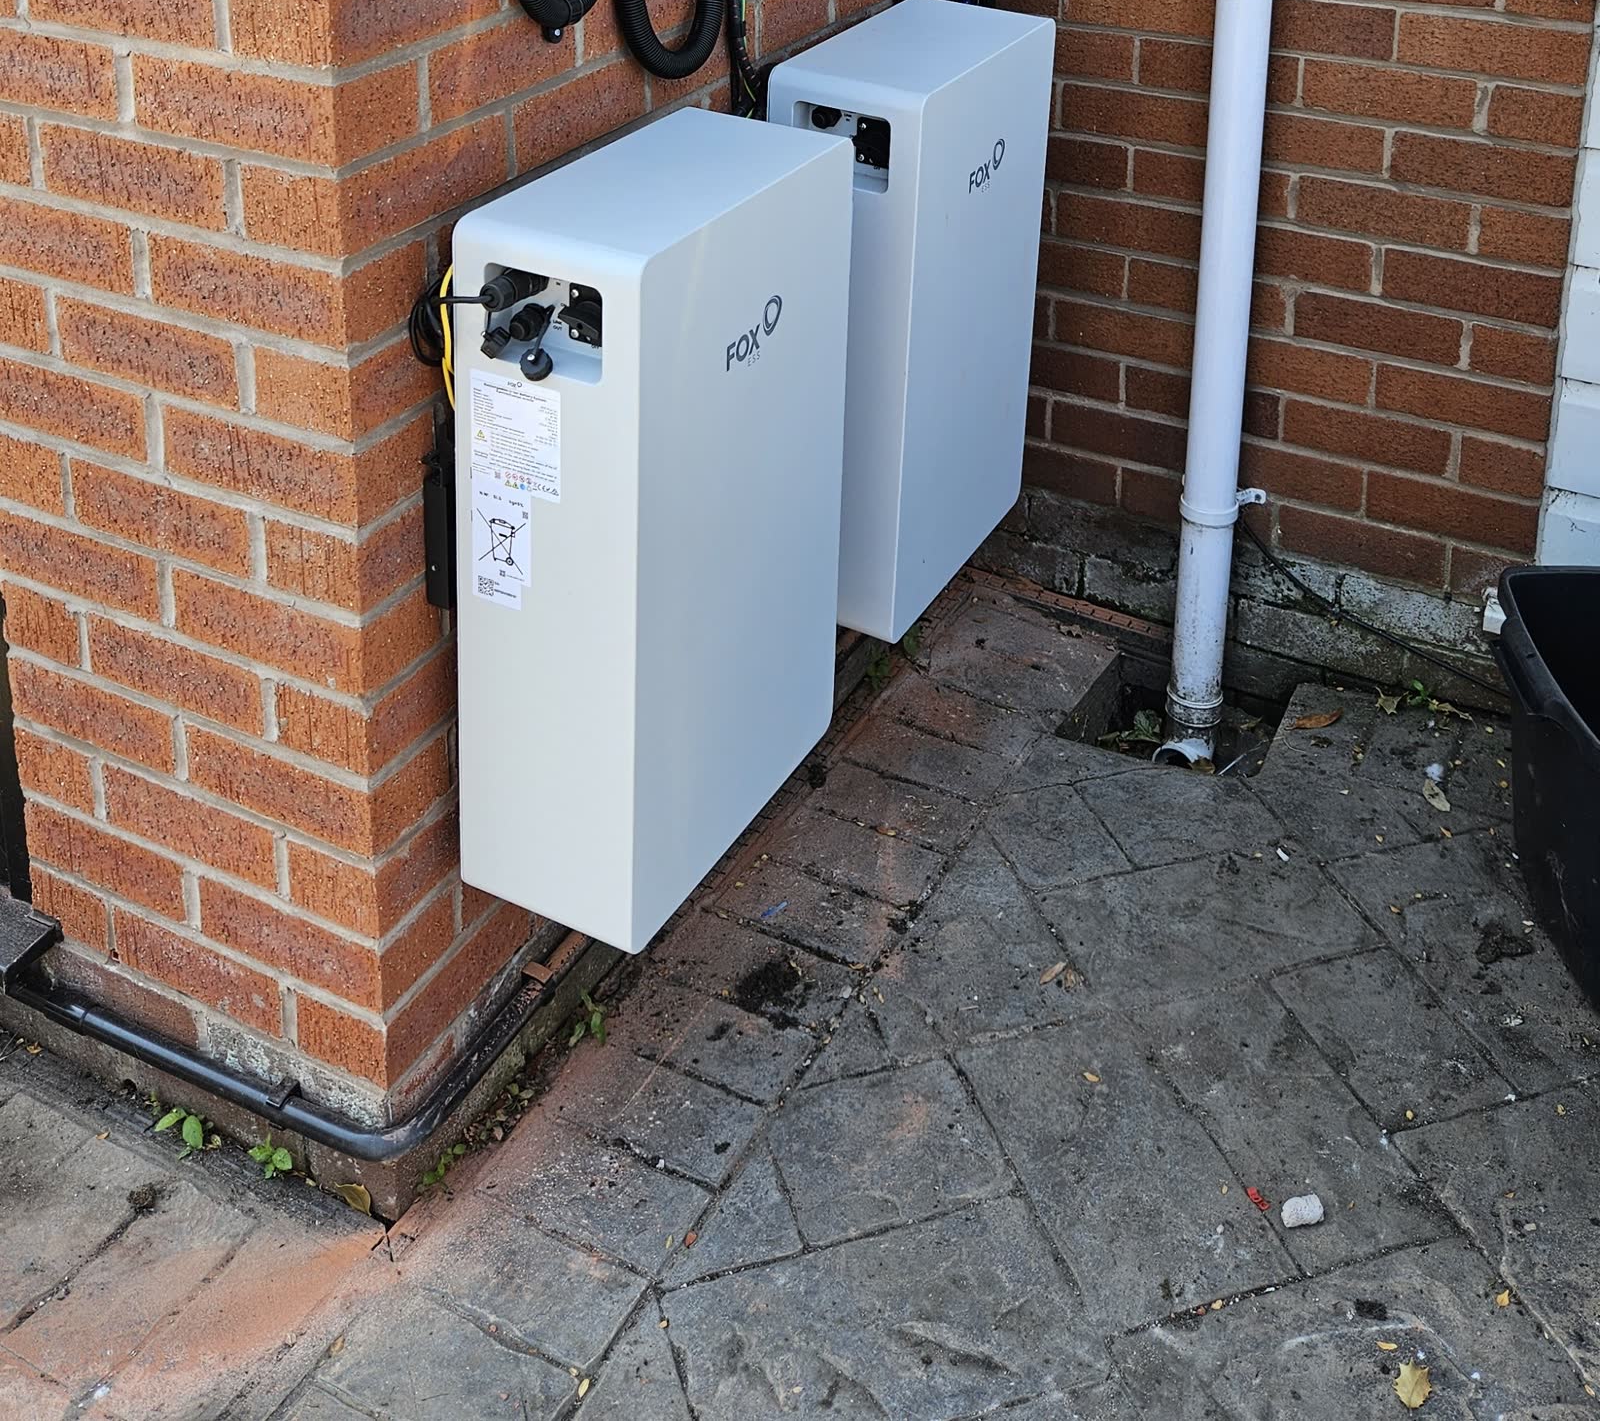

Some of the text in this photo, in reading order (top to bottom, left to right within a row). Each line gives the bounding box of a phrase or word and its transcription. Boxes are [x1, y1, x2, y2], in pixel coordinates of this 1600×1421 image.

[968, 159, 991, 194] FOX
[726, 323, 760, 372] FOX
[747, 350, 761, 367] ESS
